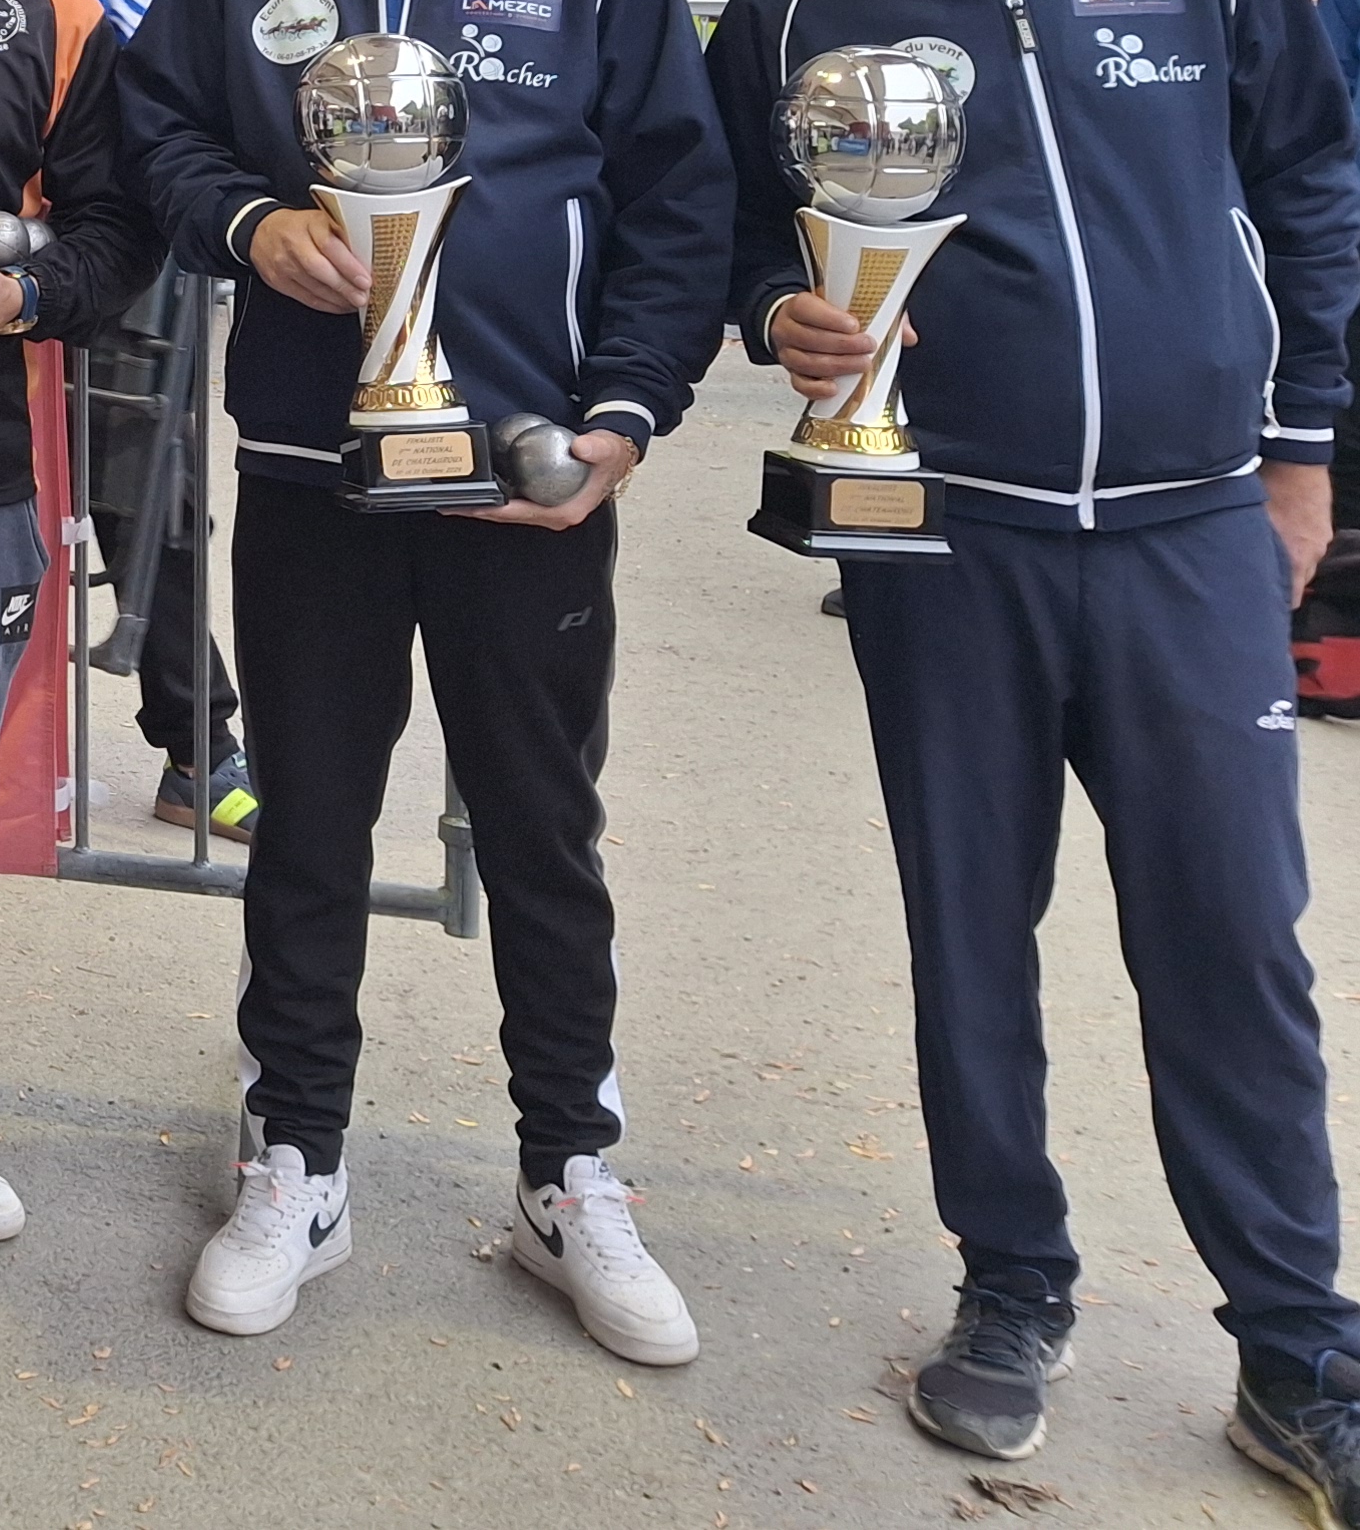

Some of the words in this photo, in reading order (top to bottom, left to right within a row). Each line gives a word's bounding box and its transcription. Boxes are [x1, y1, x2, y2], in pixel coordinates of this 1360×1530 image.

[462, 0, 552, 18] LAMEZEC
[904, 42, 923, 53] du
[929, 43, 964, 61] vent
